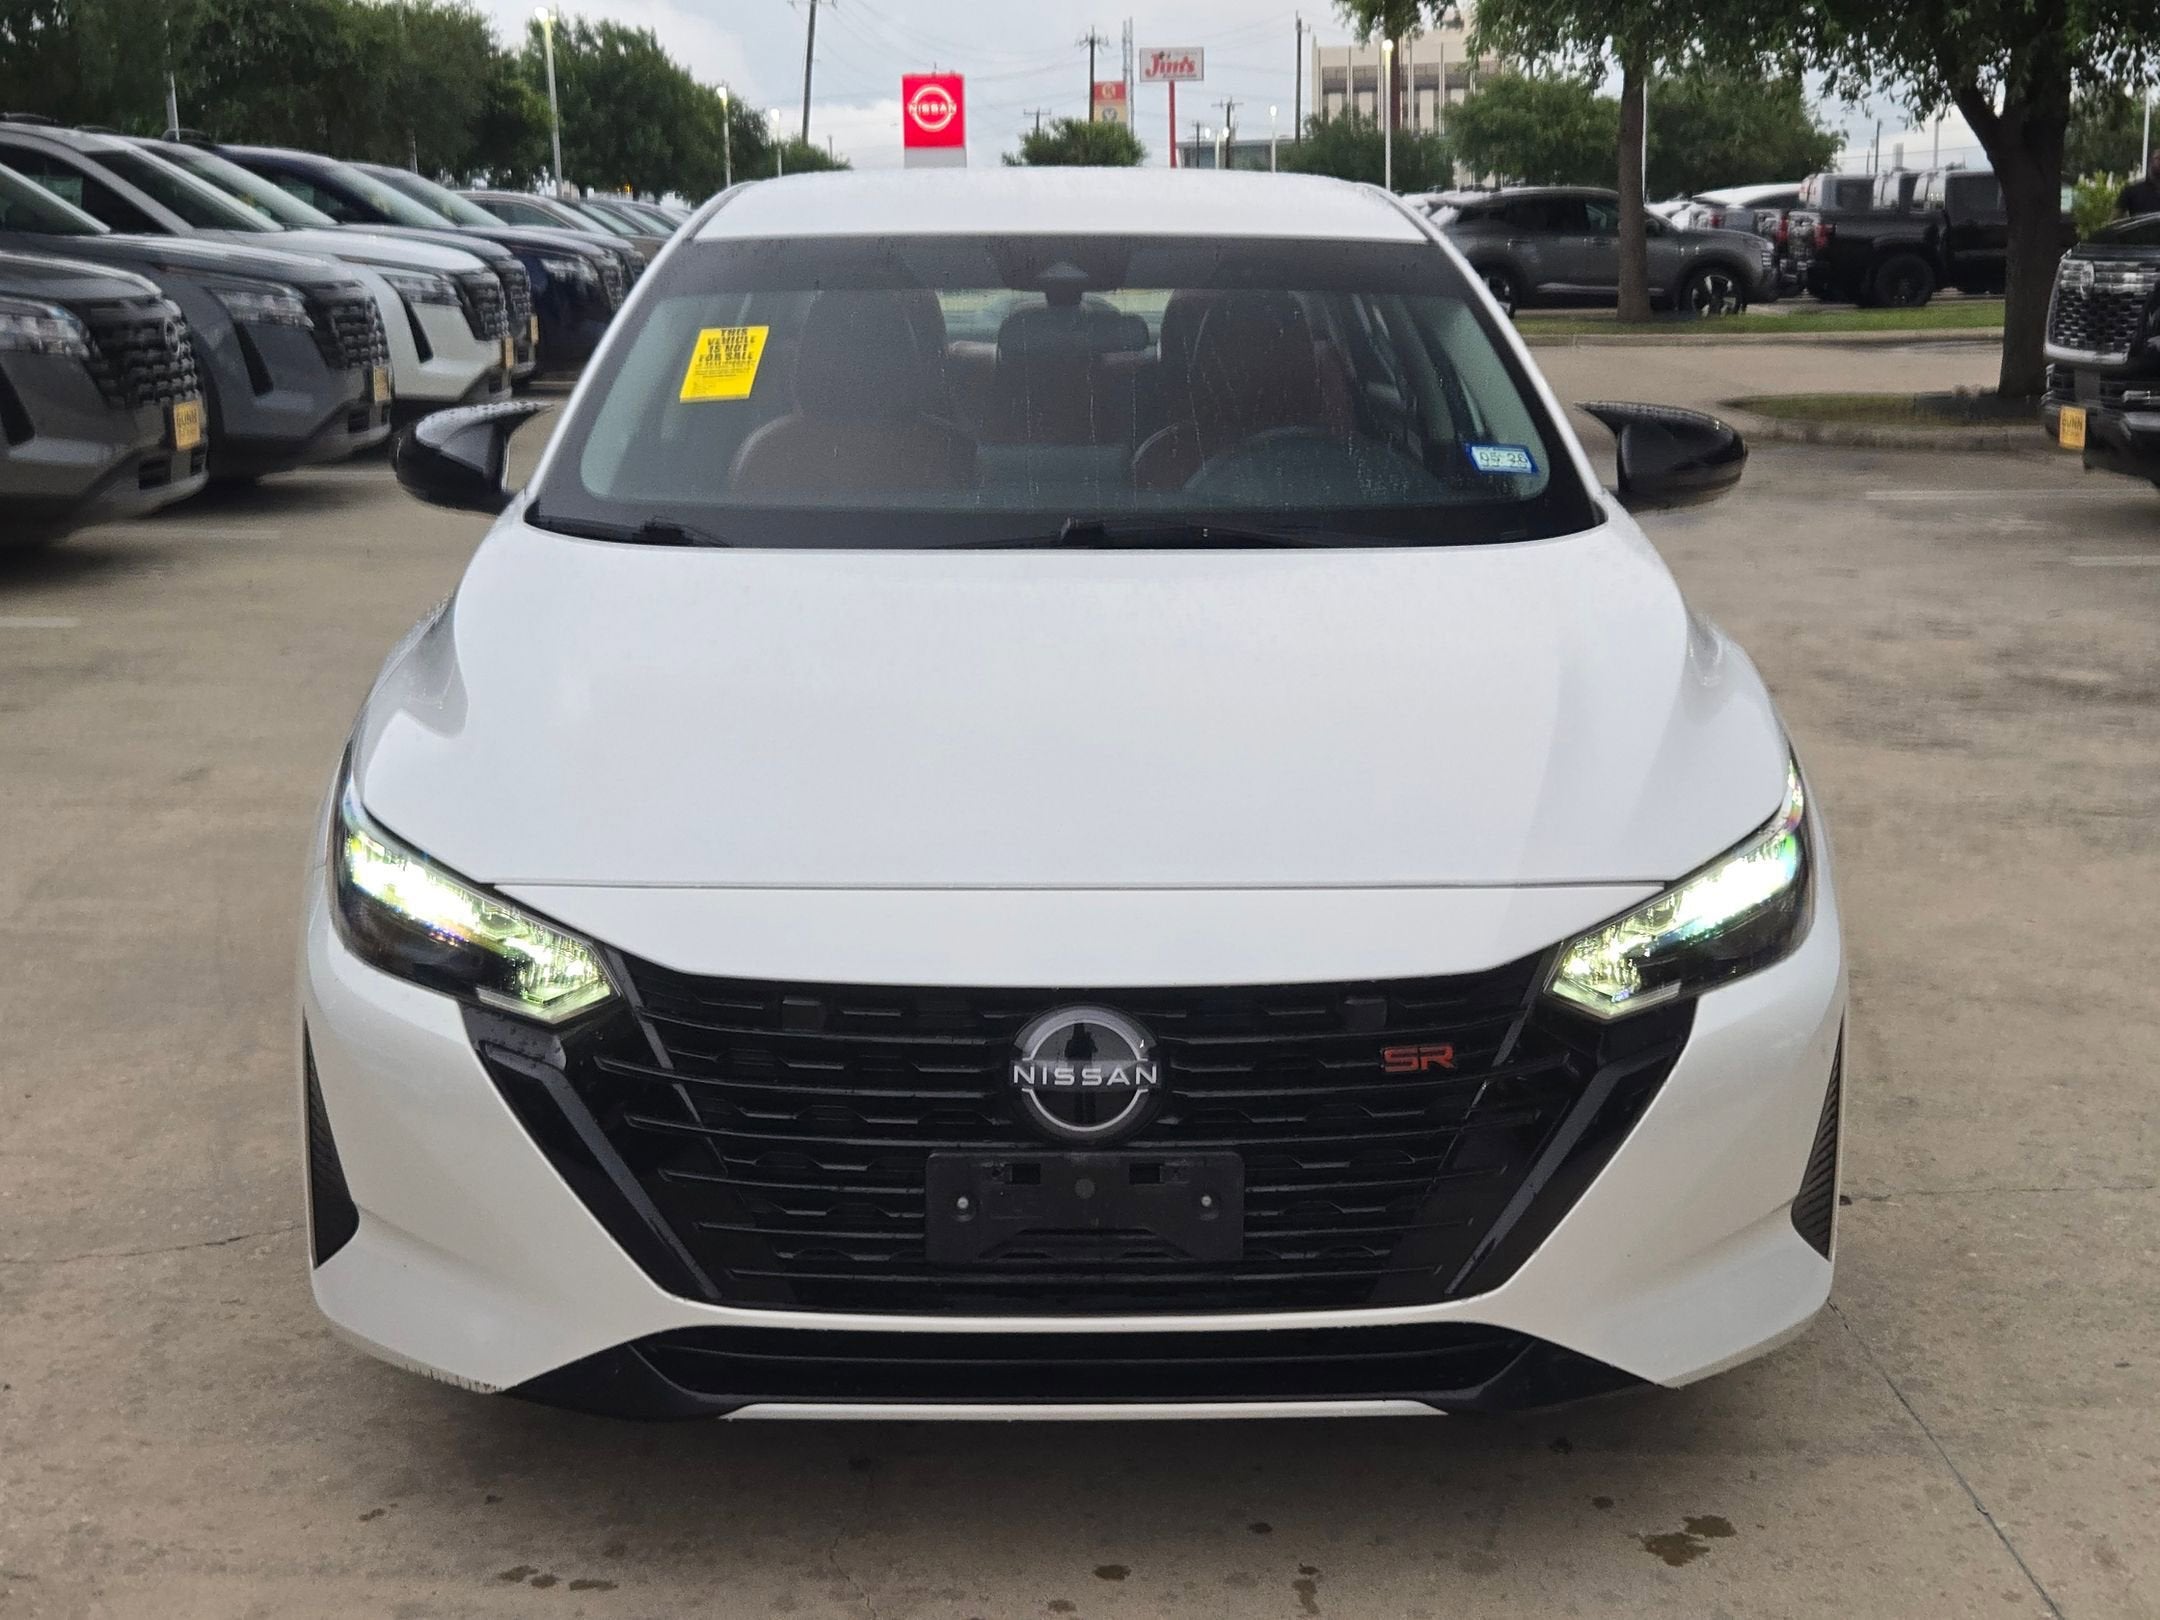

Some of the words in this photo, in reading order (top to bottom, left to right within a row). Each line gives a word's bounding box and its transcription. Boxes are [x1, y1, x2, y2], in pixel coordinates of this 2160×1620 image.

[908, 103, 957, 114] NISSAN
[1384, 1046, 1456, 1072] SR
[1013, 1065, 1157, 1086] NISSAN
